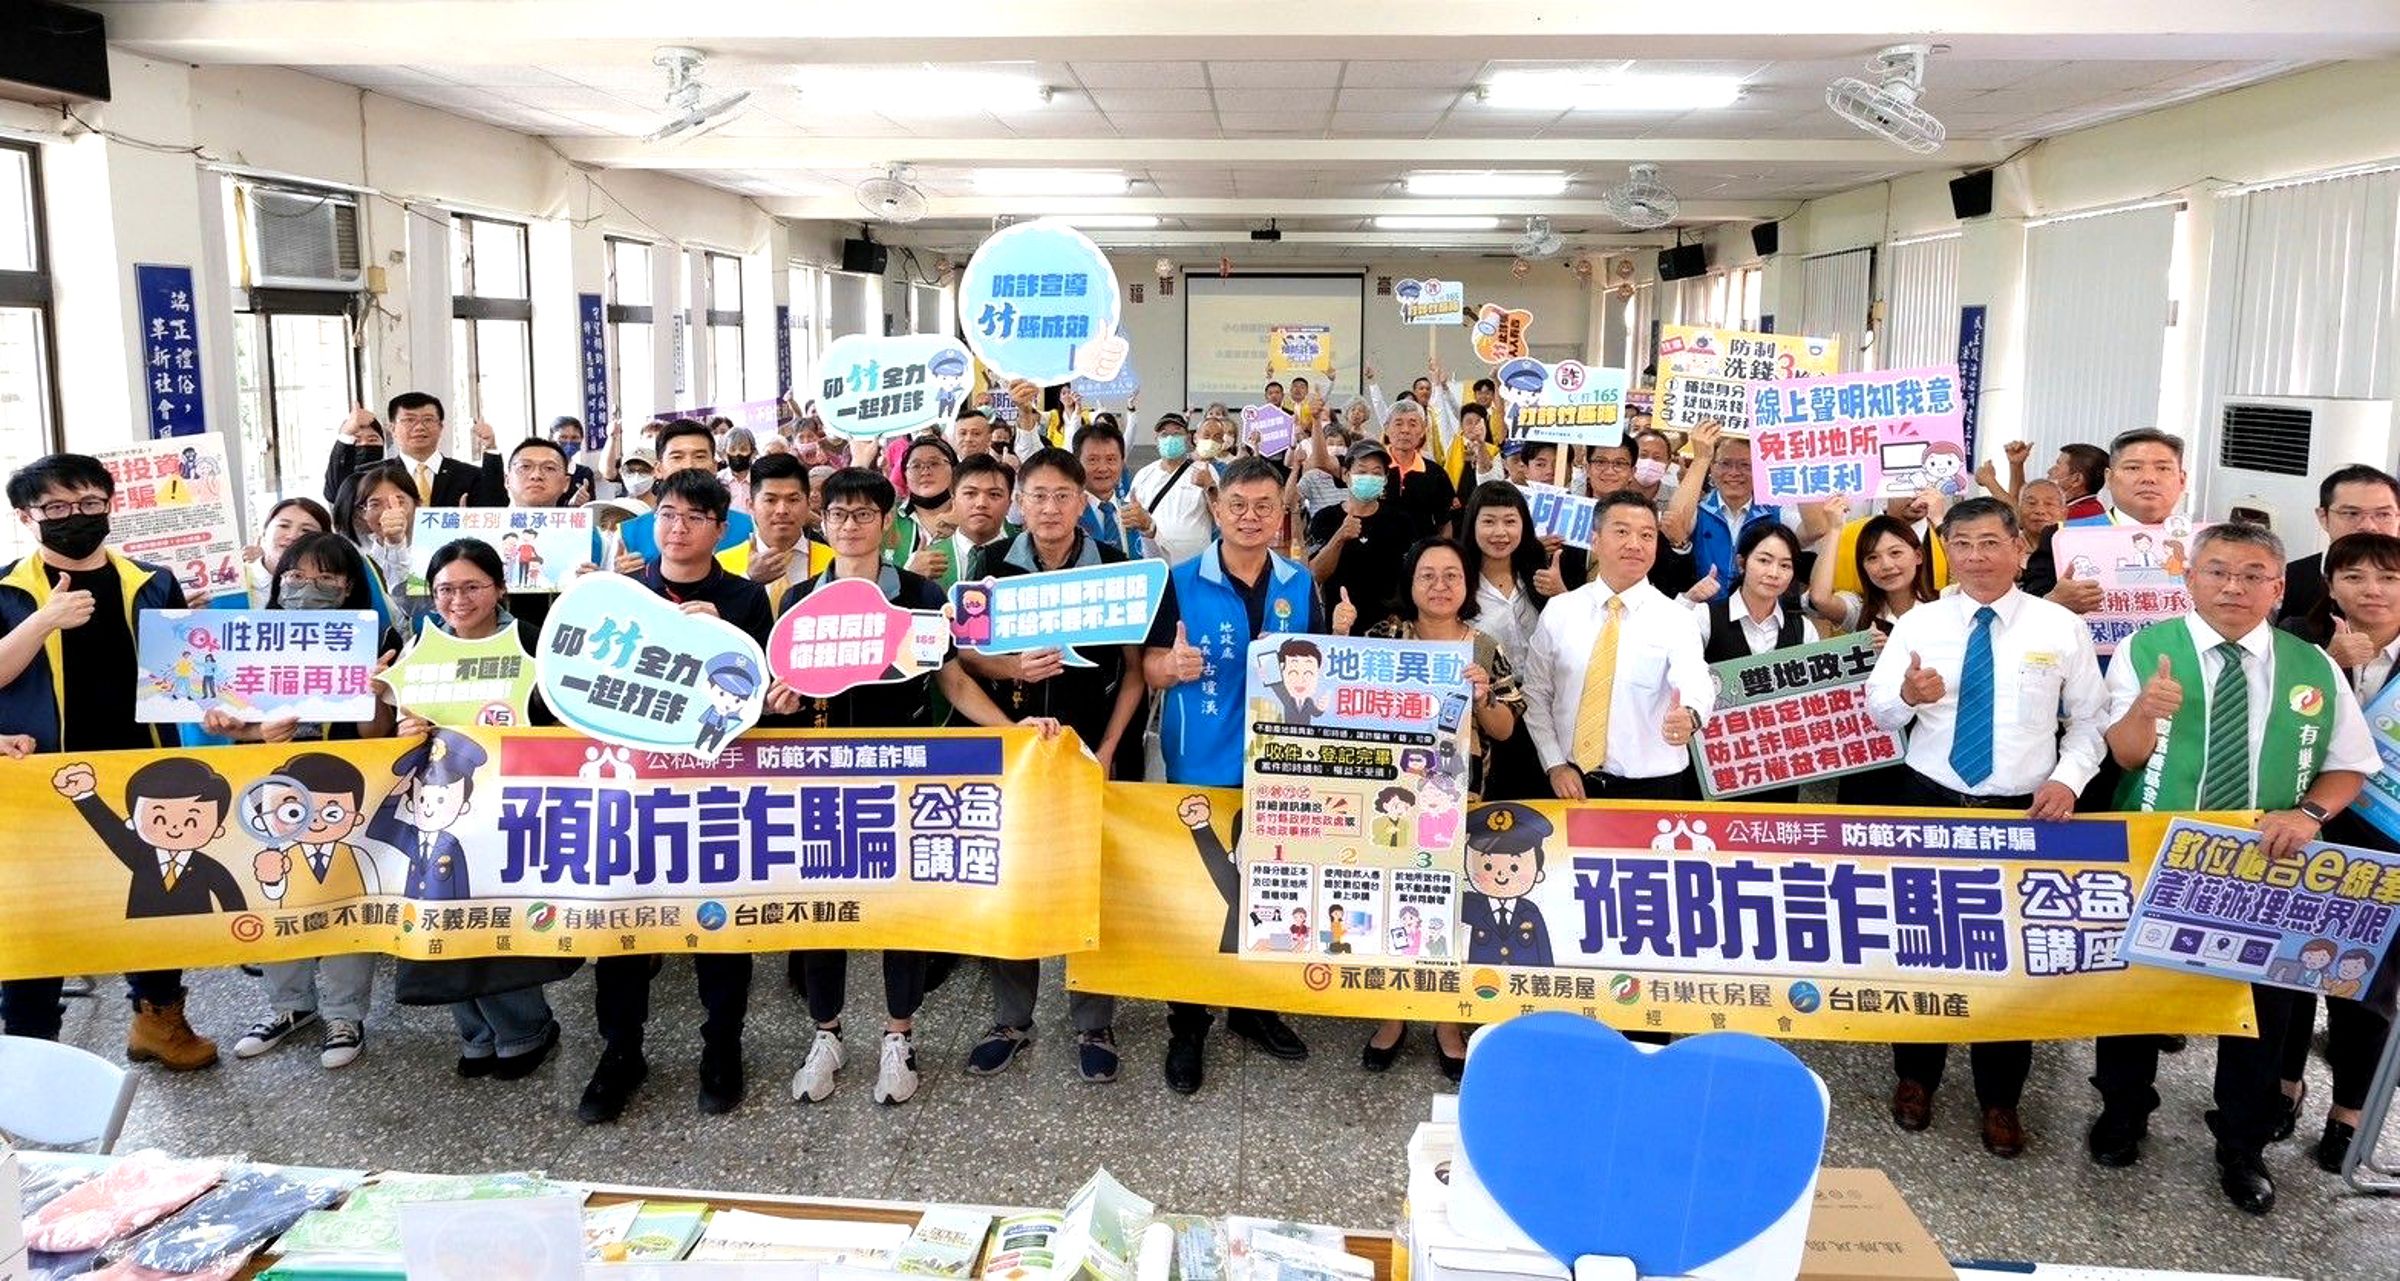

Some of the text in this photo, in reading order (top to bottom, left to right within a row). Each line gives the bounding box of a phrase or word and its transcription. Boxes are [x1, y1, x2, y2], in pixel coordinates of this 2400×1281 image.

[992, 273, 1088, 298] 防詐宣導
[1129, 284, 1144, 303] 福
[977, 301, 1089, 340] 竹縣成效
[1729, 338, 1776, 359] 防制
[822, 358, 927, 400] 卯竹全力
[1594, 387, 1619, 403] 165
[1684, 379, 1746, 399] 確認身分
[836, 389, 925, 420] 一起打詐
[1682, 394, 1749, 415] 疑似洗錢
[1754, 376, 1956, 427] 線上聲明知我意
[1756, 424, 1880, 460] 免到地所
[1768, 462, 1863, 496] 更便利
[420, 511, 588, 530] 不論性別 繼承平權
[2098, 590, 2189, 613] 辦繼承
[221, 620, 355, 653] 性別平等
[791, 611, 888, 640] 全民反詐
[2086, 619, 2153, 643] 保障
[550, 616, 705, 690] 卯竹全力
[1326, 645, 1465, 686] 地籍異動
[233, 664, 368, 696] 幸福再現
[1739, 645, 1877, 698] 雙地政士
[559, 674, 691, 726] 一起打詐
[757, 743, 927, 770] 防範不動產詐騙
[1712, 734, 1897, 793] 雙方權益有保障
[909, 784, 1001, 832] 公益
[499, 784, 898, 886] 預防詐騙
[1726, 819, 2037, 852] 公私聯手 防範不動產詐騙
[909, 834, 1000, 886] 講座
[1273, 845, 1284, 861] 1
[1338, 848, 1358, 865] 2
[1416, 852, 1433, 869] 3
[2018, 870, 2133, 923] 公益
[273, 901, 862, 937] 永慶不動產 永義房屋 有巢氏房屋 台慶不動產
[1573, 855, 2010, 978] 預防詐騙
[2022, 924, 2131, 978] 講座
[1339, 964, 1970, 1019] 永慶不動產 永義房屋 有巢氏房屋 台慶不動產
